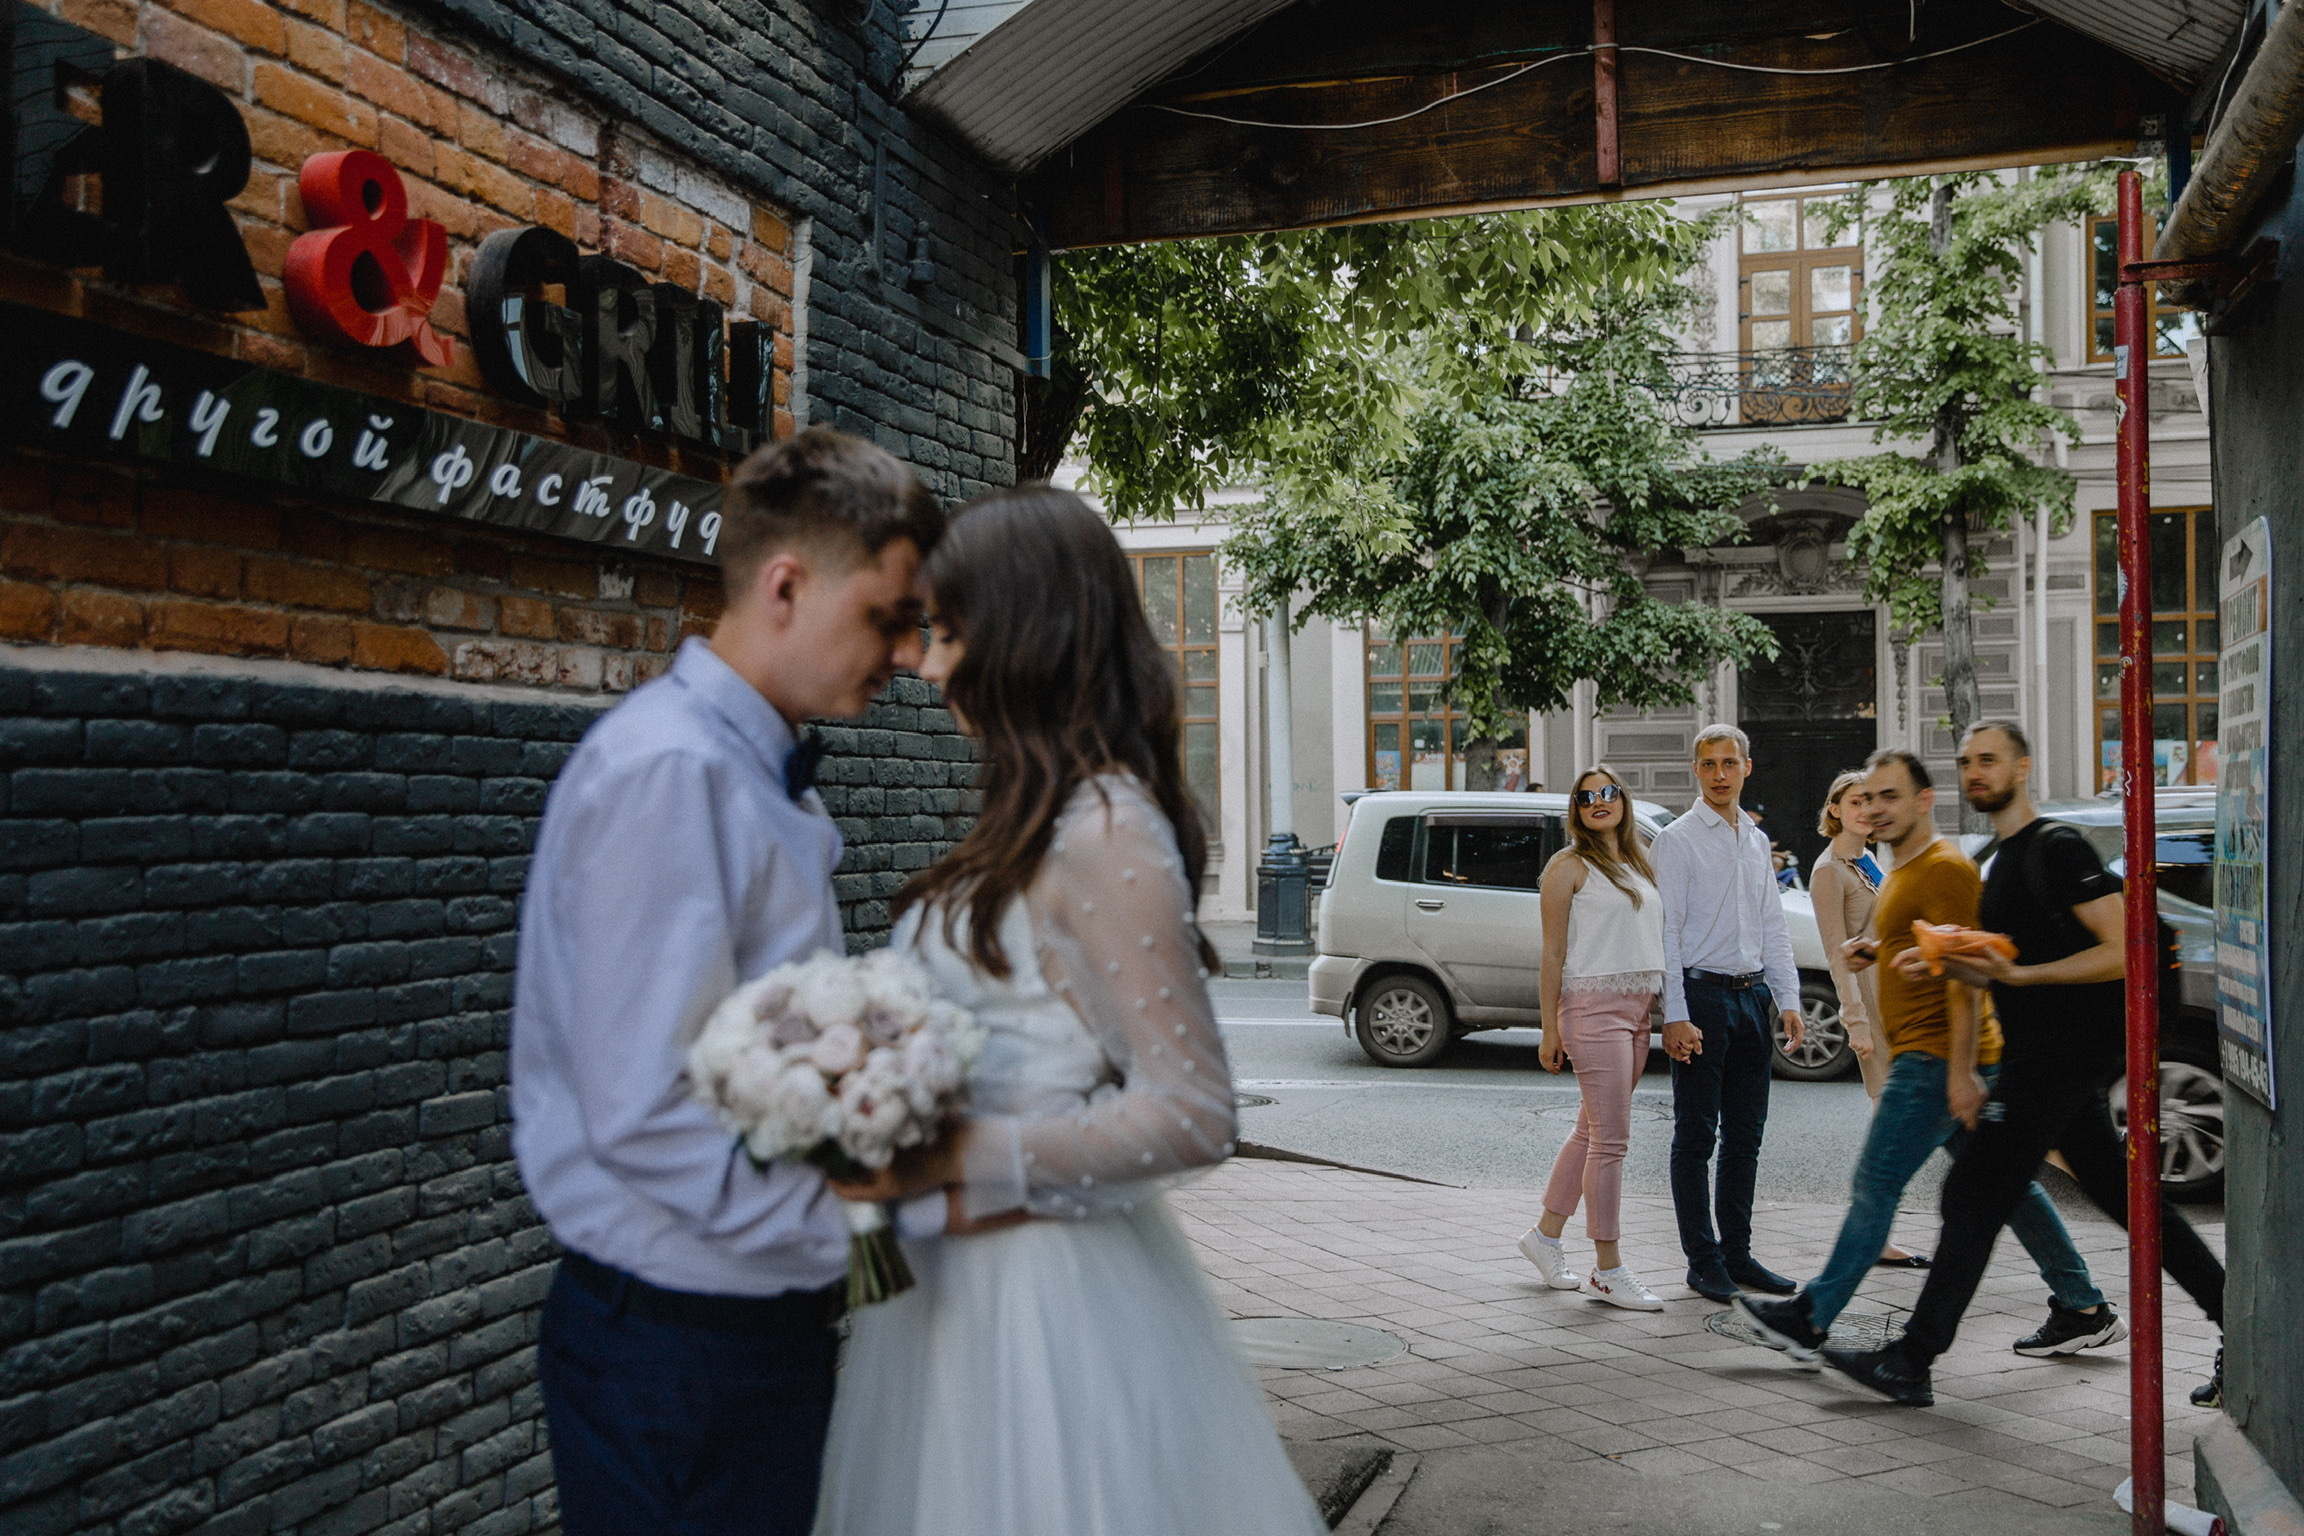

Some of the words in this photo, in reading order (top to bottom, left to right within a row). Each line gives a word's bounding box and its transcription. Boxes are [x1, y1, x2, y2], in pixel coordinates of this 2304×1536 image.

[286, 149, 455, 367] &
[40, 358, 394, 472] другой
[431, 443, 724, 557] фастфуд
[2228, 584, 2258, 644] РЕМОНТ
